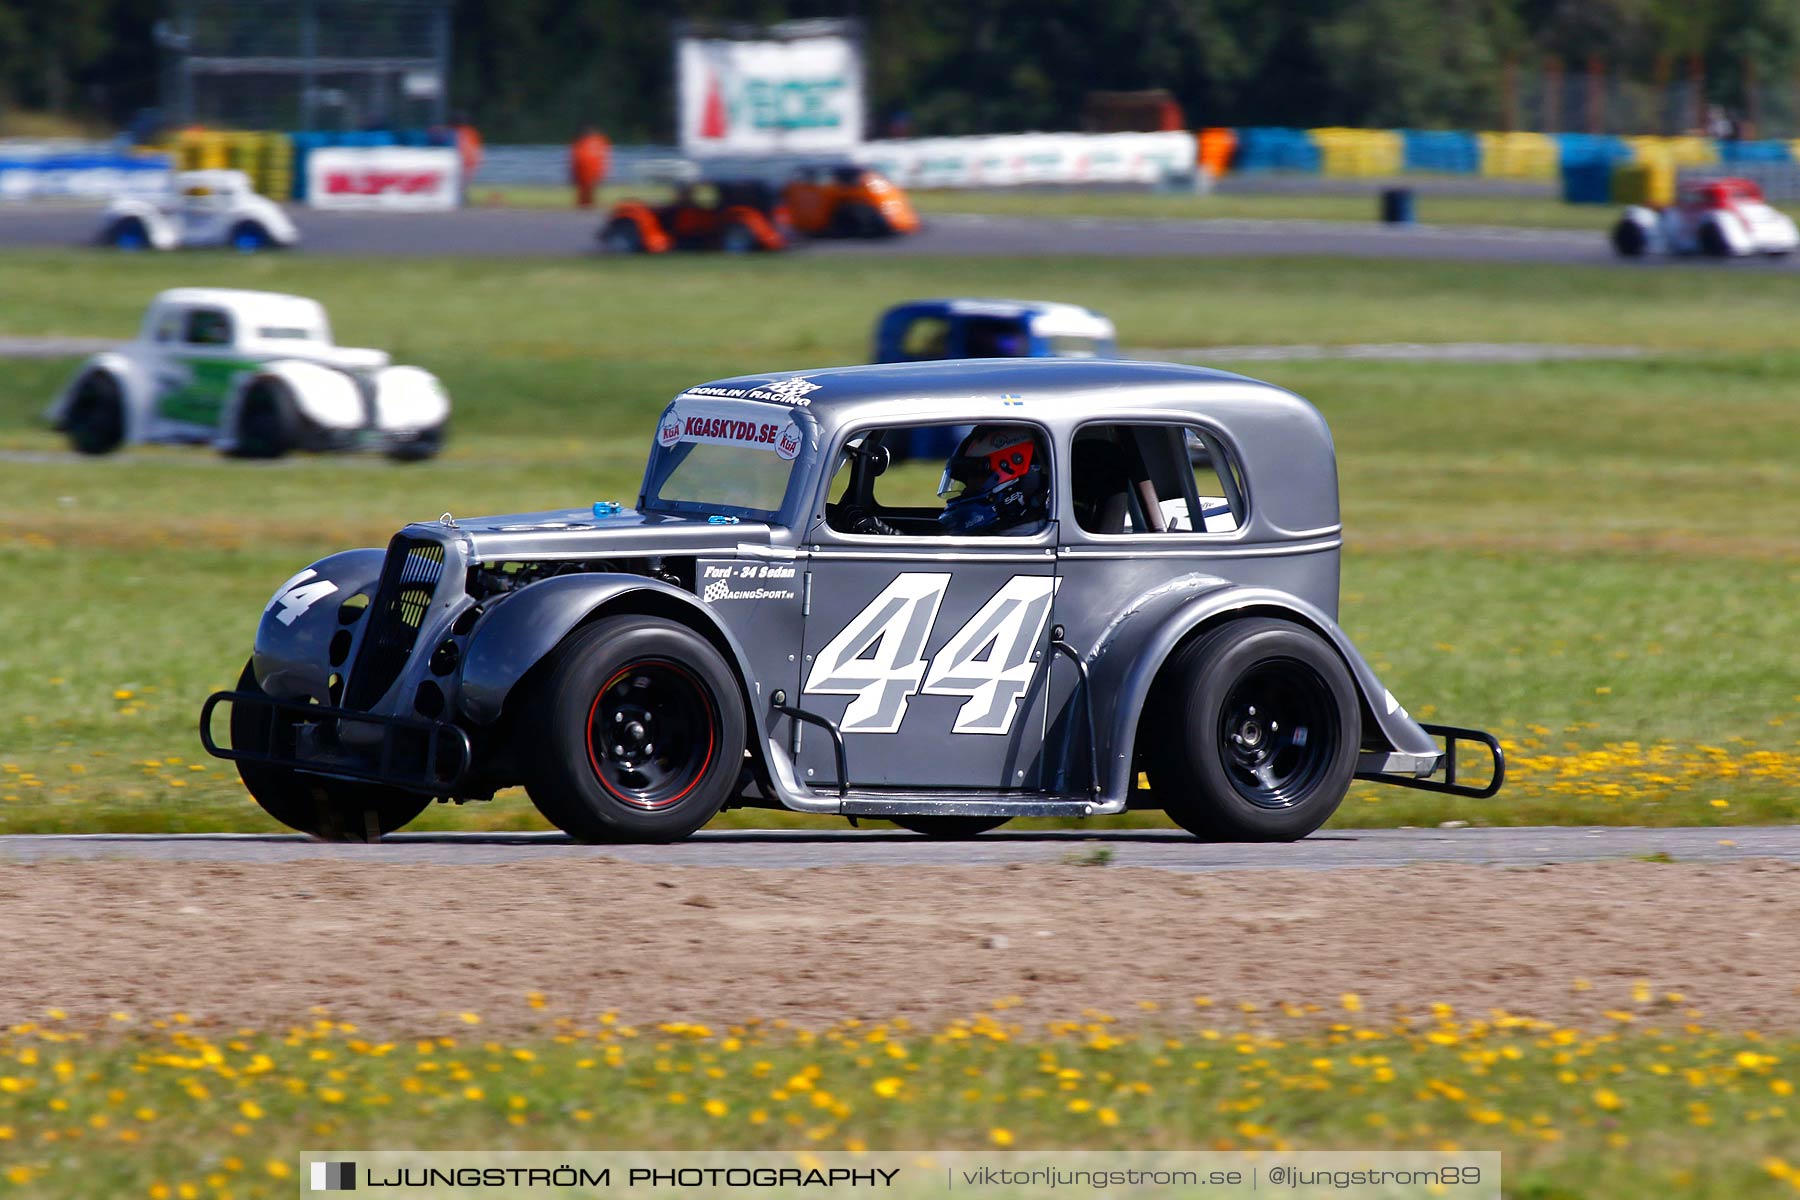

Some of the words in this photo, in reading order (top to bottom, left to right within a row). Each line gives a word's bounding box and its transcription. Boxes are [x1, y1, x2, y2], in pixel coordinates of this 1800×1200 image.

[687, 387, 746, 398] BOHLIN
[750, 390, 812, 407] RACING
[662, 425, 680, 440] KGA
[684, 416, 779, 444] KGASKYDD.SE
[779, 435, 797, 453] KGA
[703, 566, 733, 578] Ford
[739, 566, 758, 578] 34
[758, 566, 796, 578] Sedan
[802, 572, 1064, 735] 44
